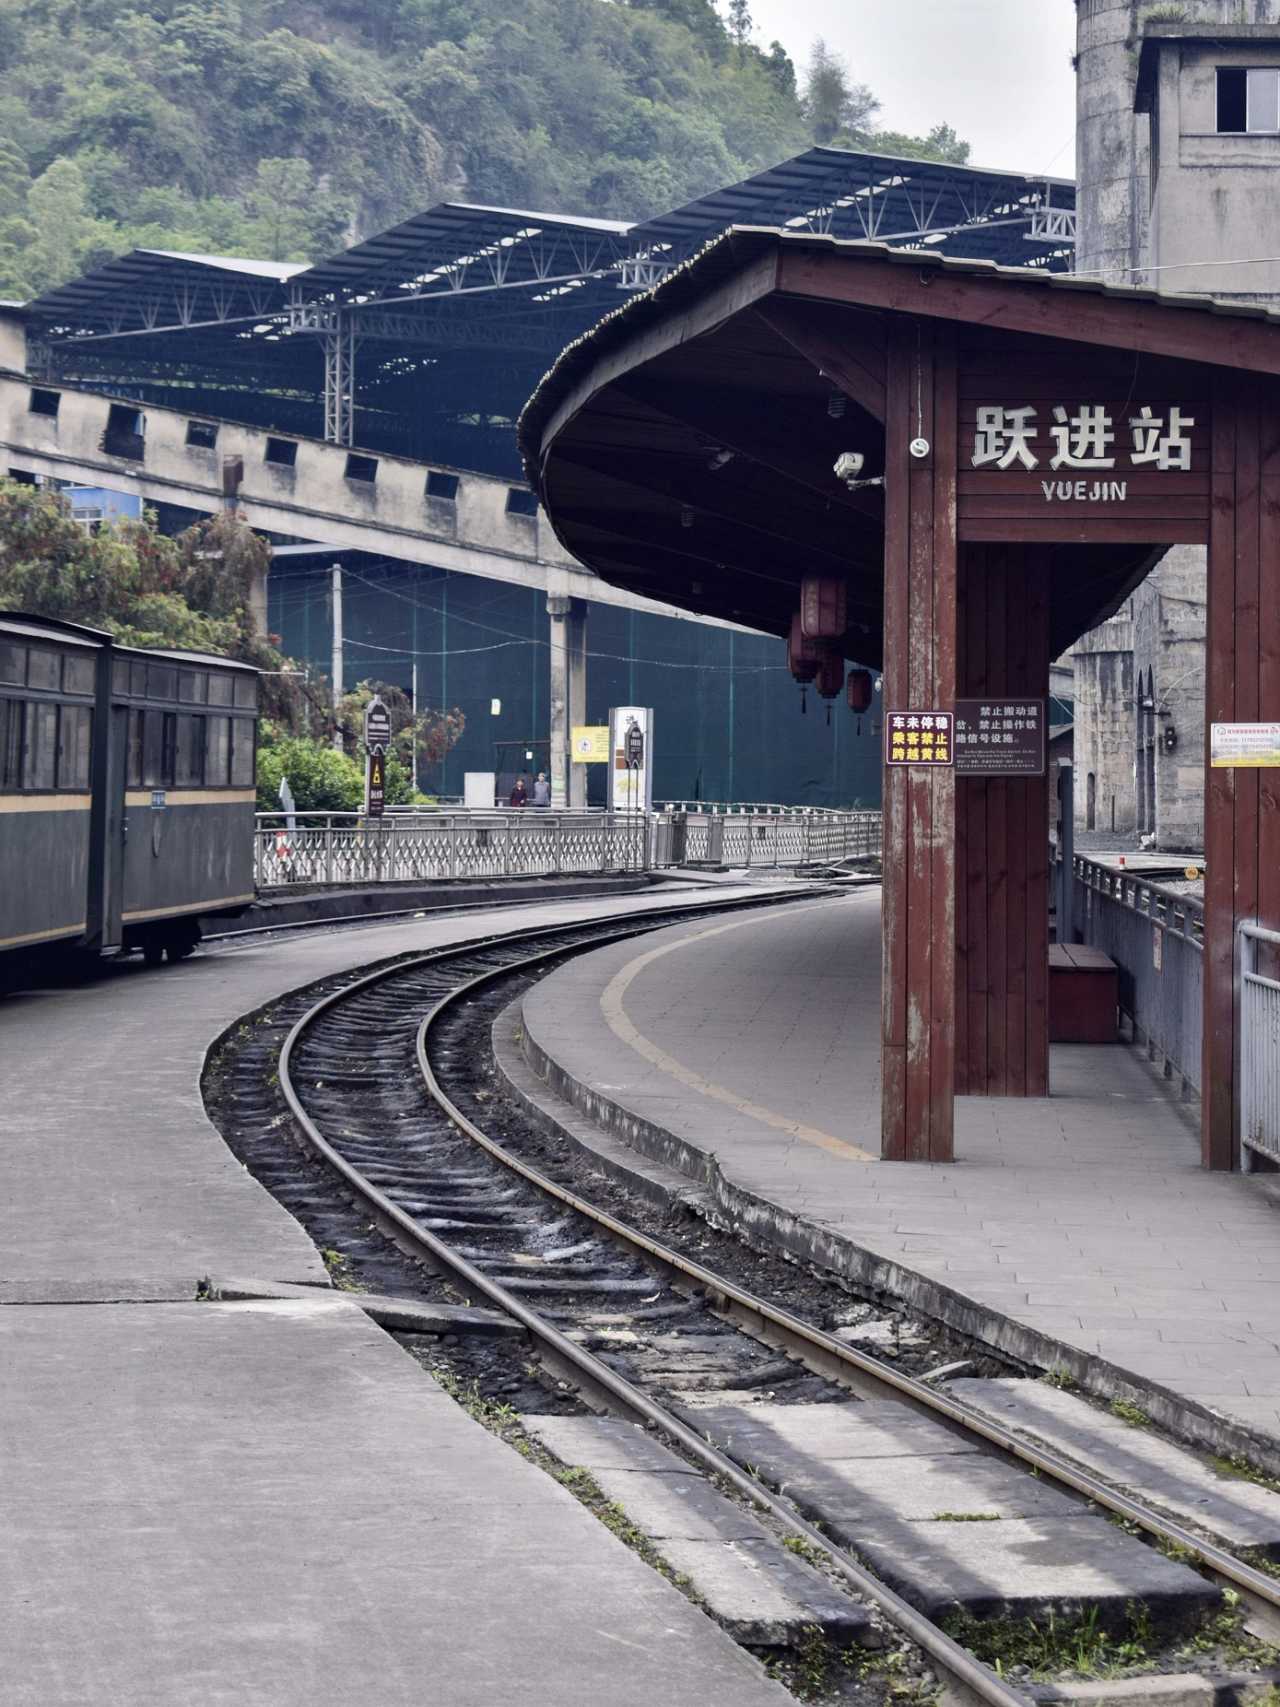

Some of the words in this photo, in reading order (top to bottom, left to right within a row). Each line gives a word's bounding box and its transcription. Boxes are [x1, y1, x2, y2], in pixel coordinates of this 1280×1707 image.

[971, 405, 1195, 471] 跃进站
[1041, 480, 1127, 501] YUEJIN
[892, 716, 948, 730] 车未停稳
[892, 731, 948, 745] 乘客禁止
[892, 747, 949, 761] 跨越黄线
